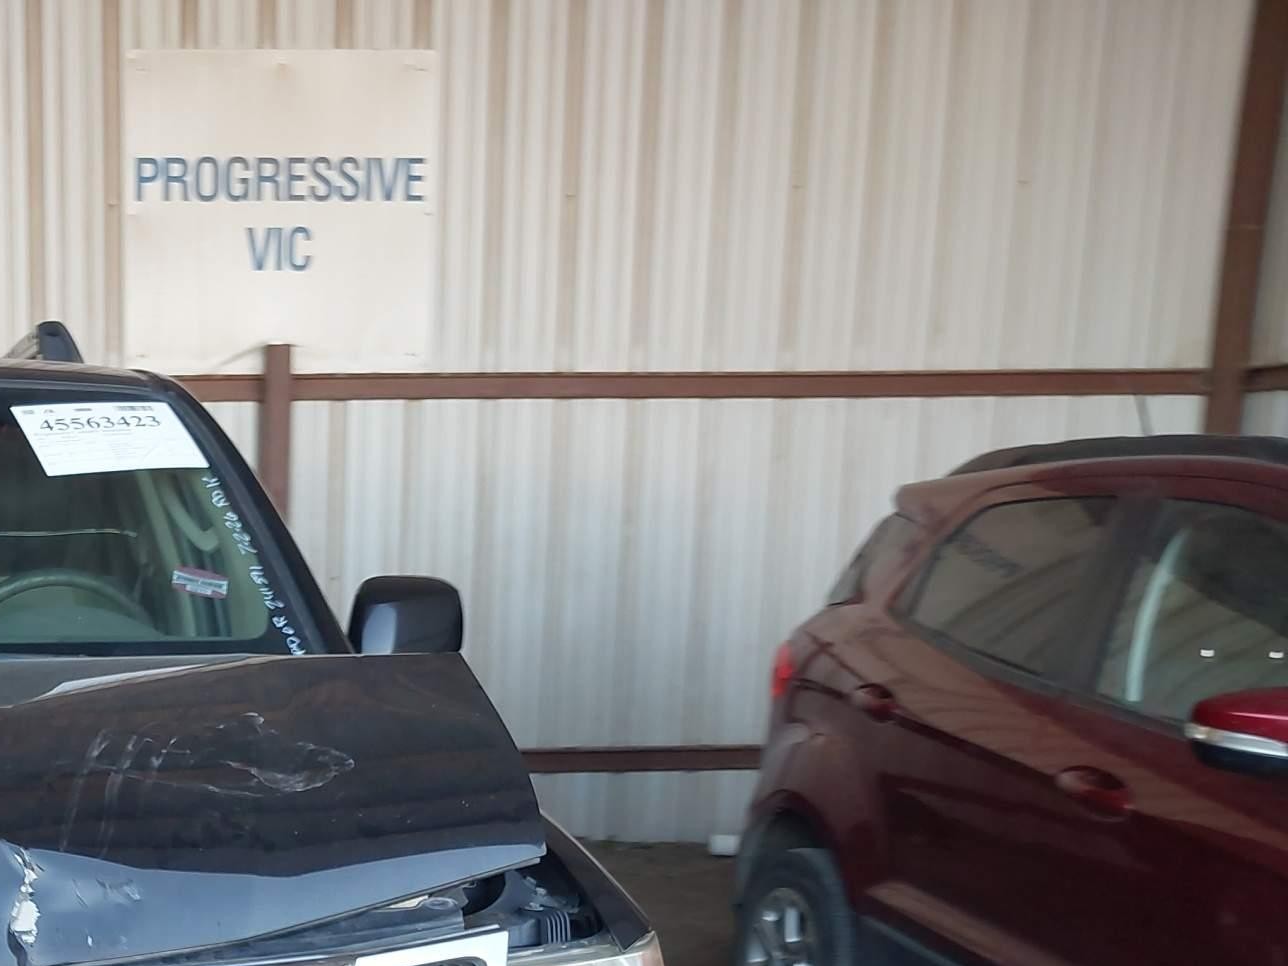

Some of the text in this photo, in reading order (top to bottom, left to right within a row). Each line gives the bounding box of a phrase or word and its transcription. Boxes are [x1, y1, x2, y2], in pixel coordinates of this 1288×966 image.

[135, 156, 426, 202] PROGRESSIVE
[247, 226, 311, 271] VIC
[40, 414, 161, 432] 45563423
